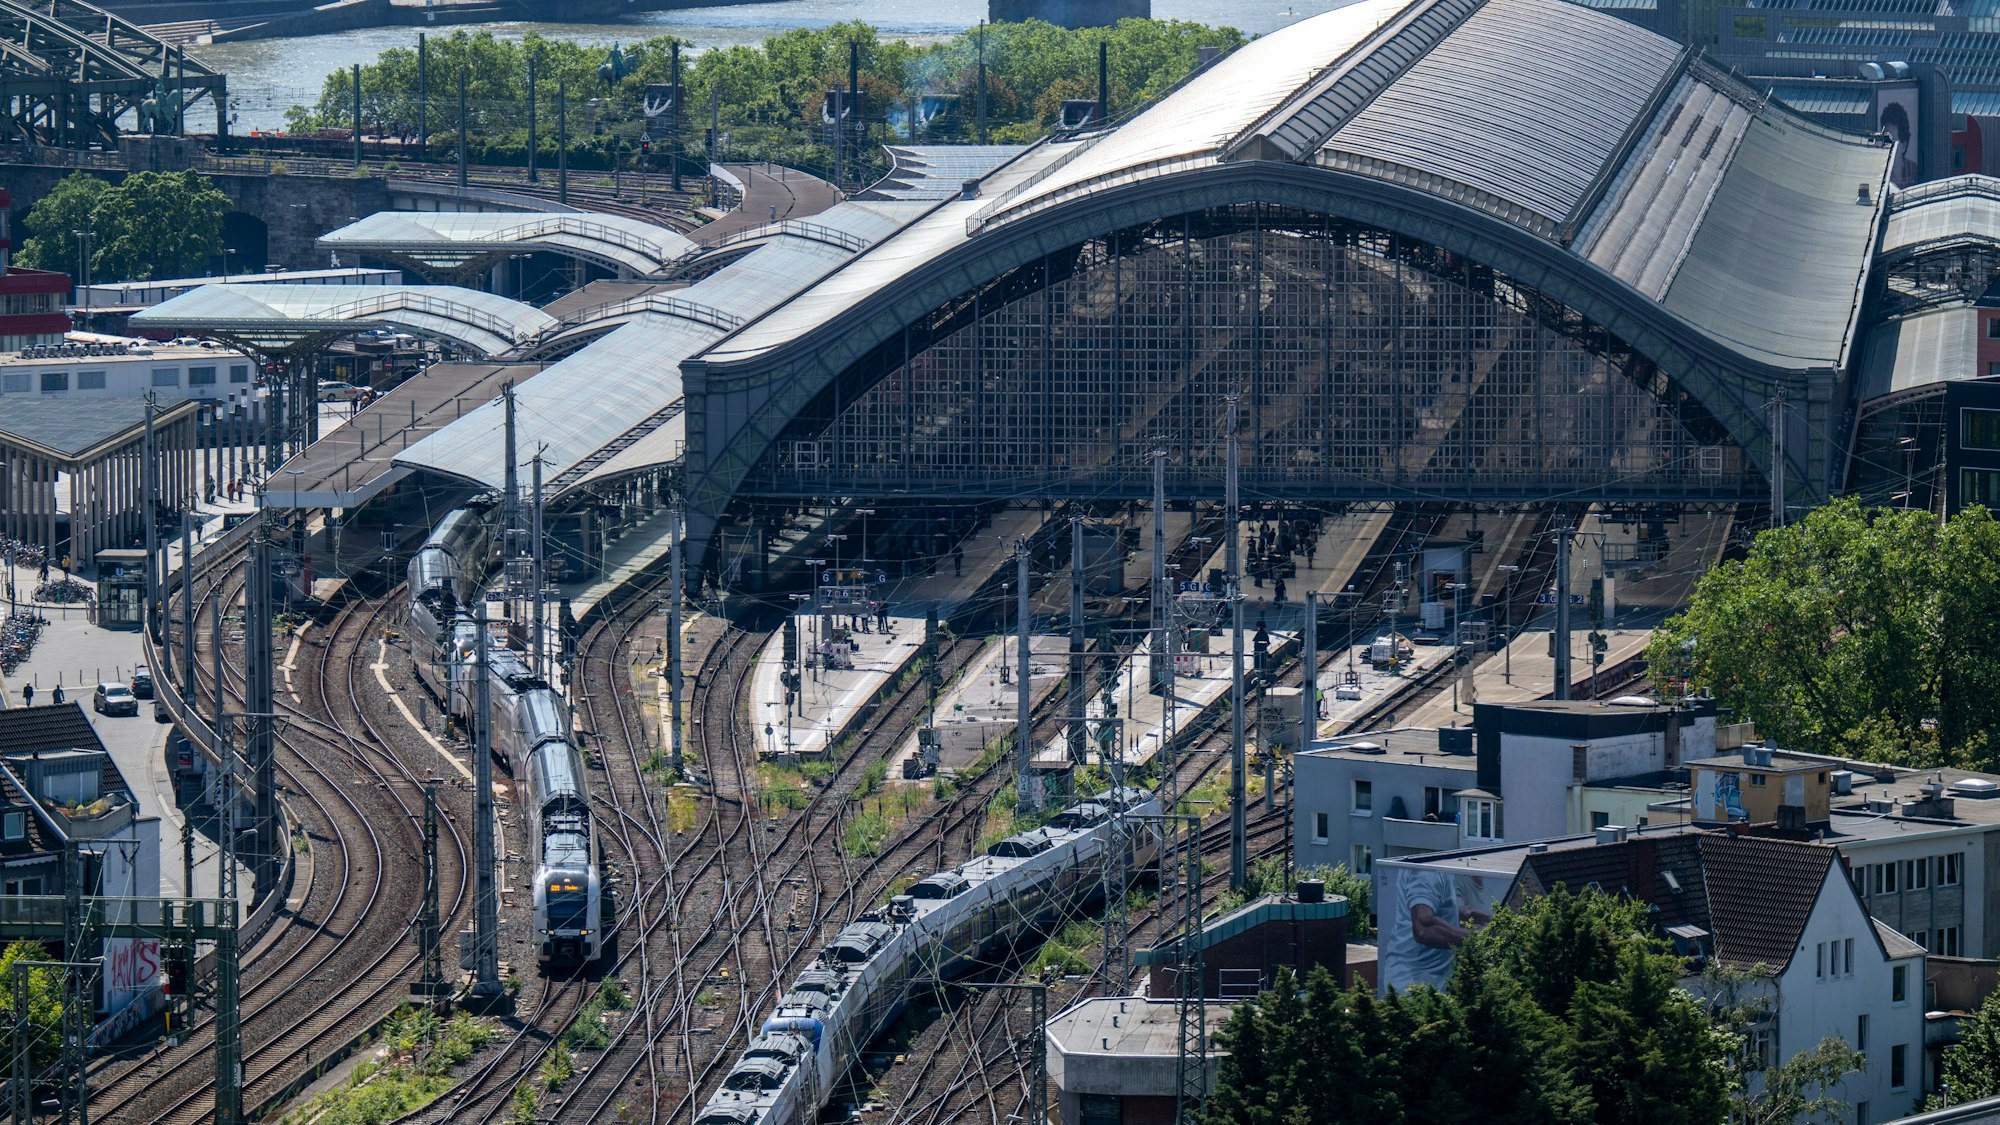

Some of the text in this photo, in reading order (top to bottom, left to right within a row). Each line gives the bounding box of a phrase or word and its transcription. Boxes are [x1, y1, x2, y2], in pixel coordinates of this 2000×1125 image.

[116, 568, 124, 576] U
[822, 573, 830, 582] G
[878, 574, 886, 583] G
[1180, 582, 1196, 591] 5 G
[486, 592, 494, 600] G
[842, 590, 848, 598] 6
[1540, 594, 1546, 602] 3
[1577, 595, 1582, 603] 2
